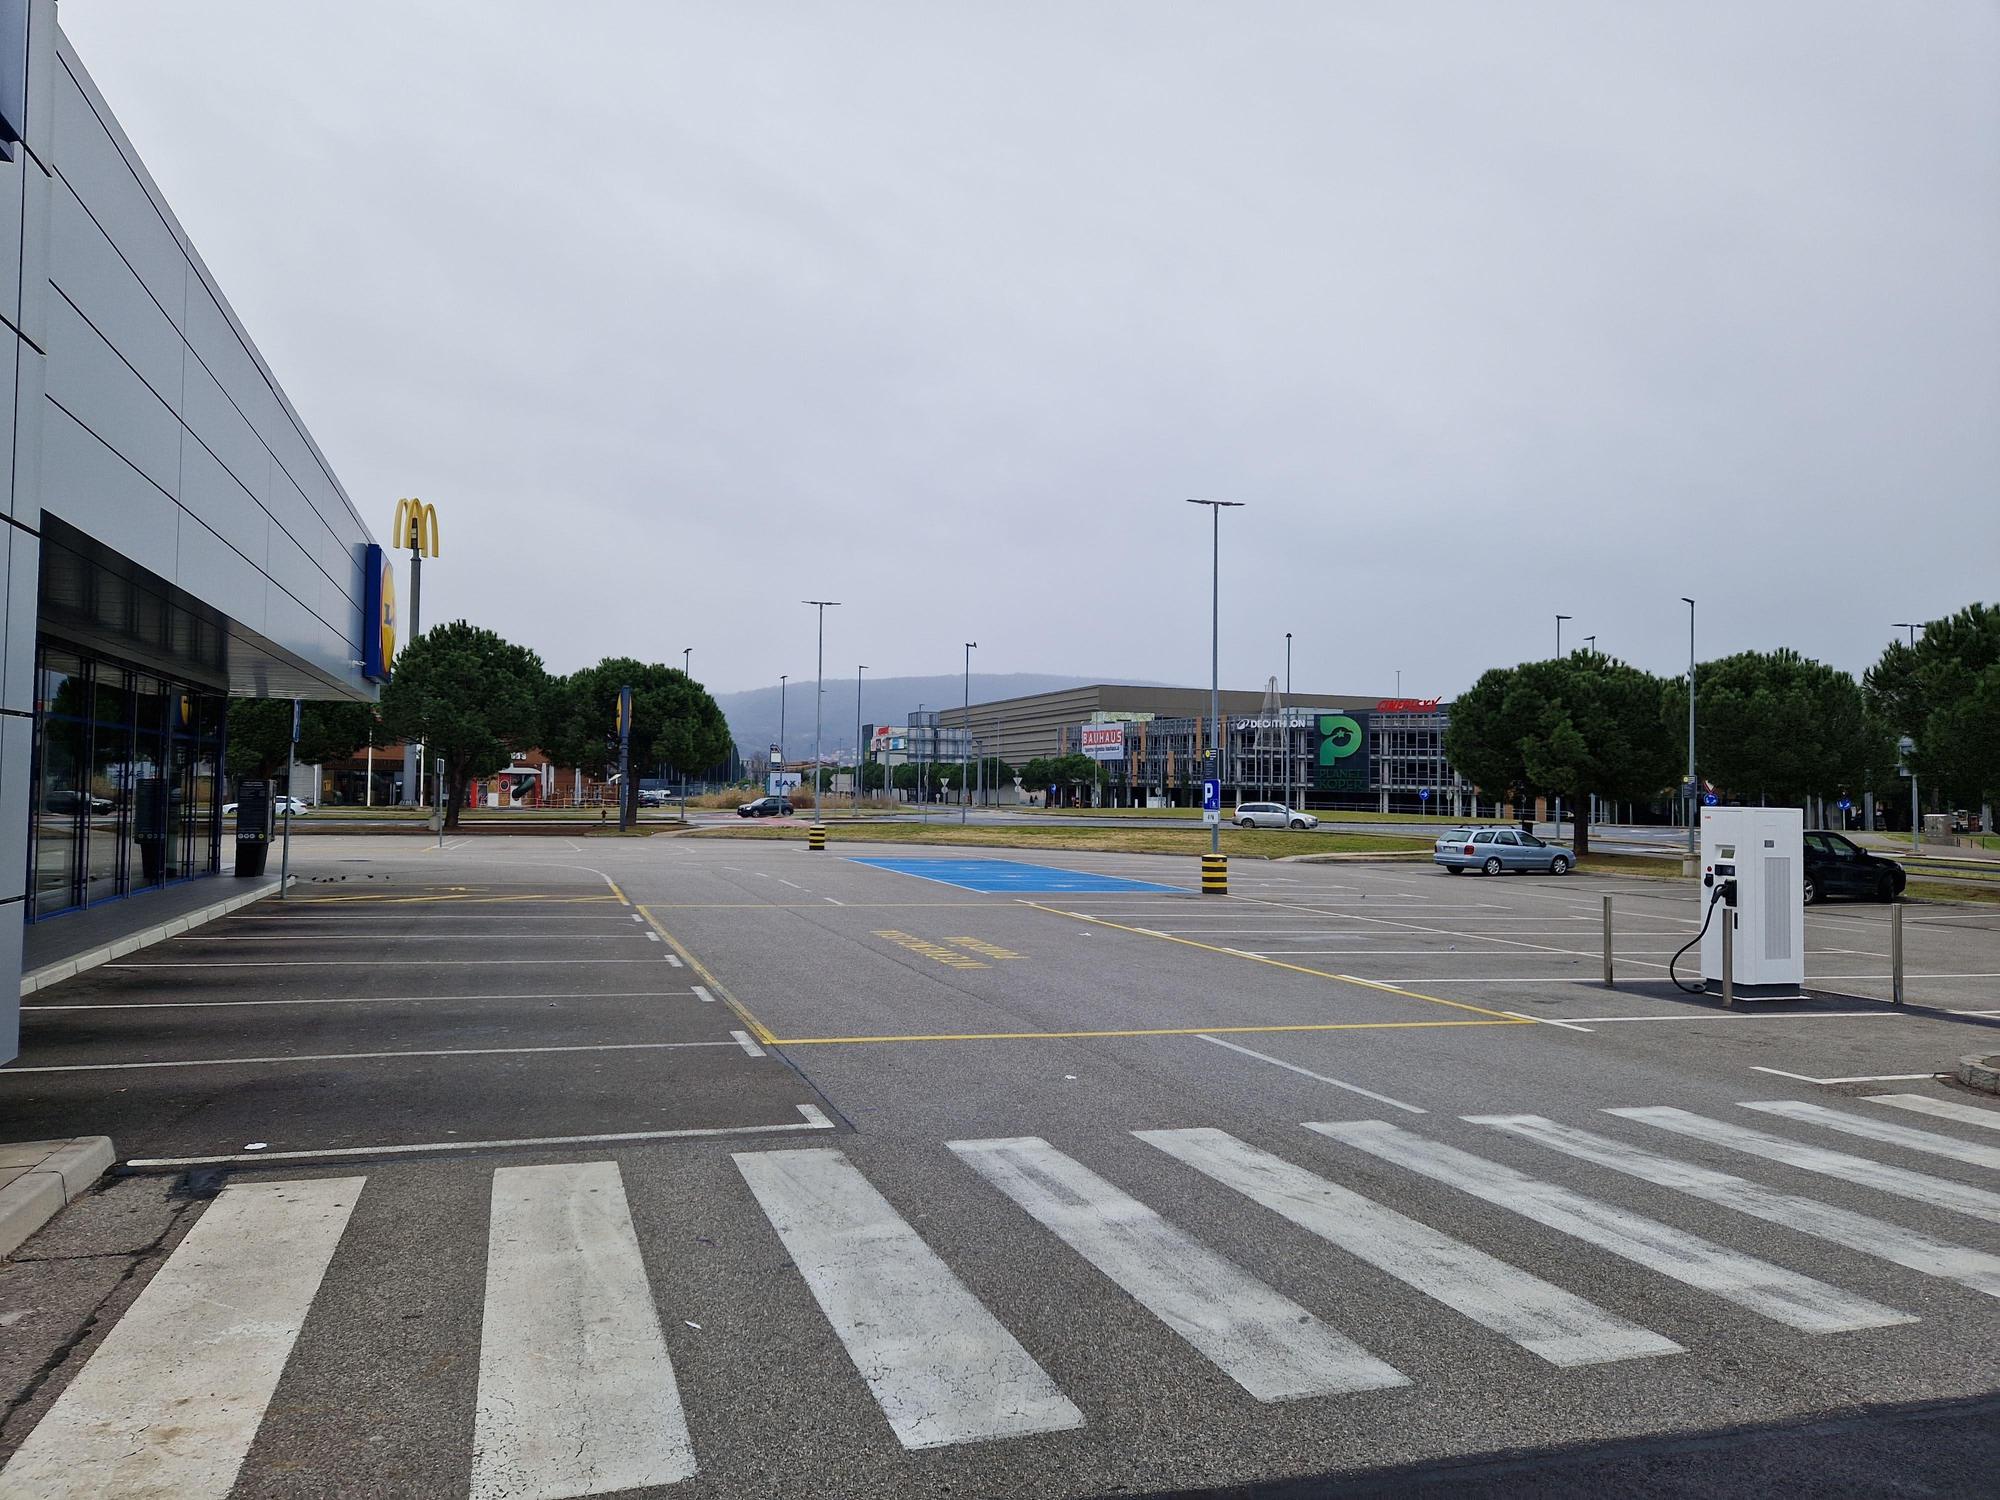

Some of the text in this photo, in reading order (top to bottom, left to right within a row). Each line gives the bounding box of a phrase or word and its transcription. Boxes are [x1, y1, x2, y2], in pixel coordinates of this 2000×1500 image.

[1251, 719, 1305, 728] DECATHON
[1083, 731, 1122, 744] BAUHAUS
[1320, 768, 1361, 778] PLANET
[1320, 779, 1362, 790] KOPER
[1204, 782, 1214, 804] P
